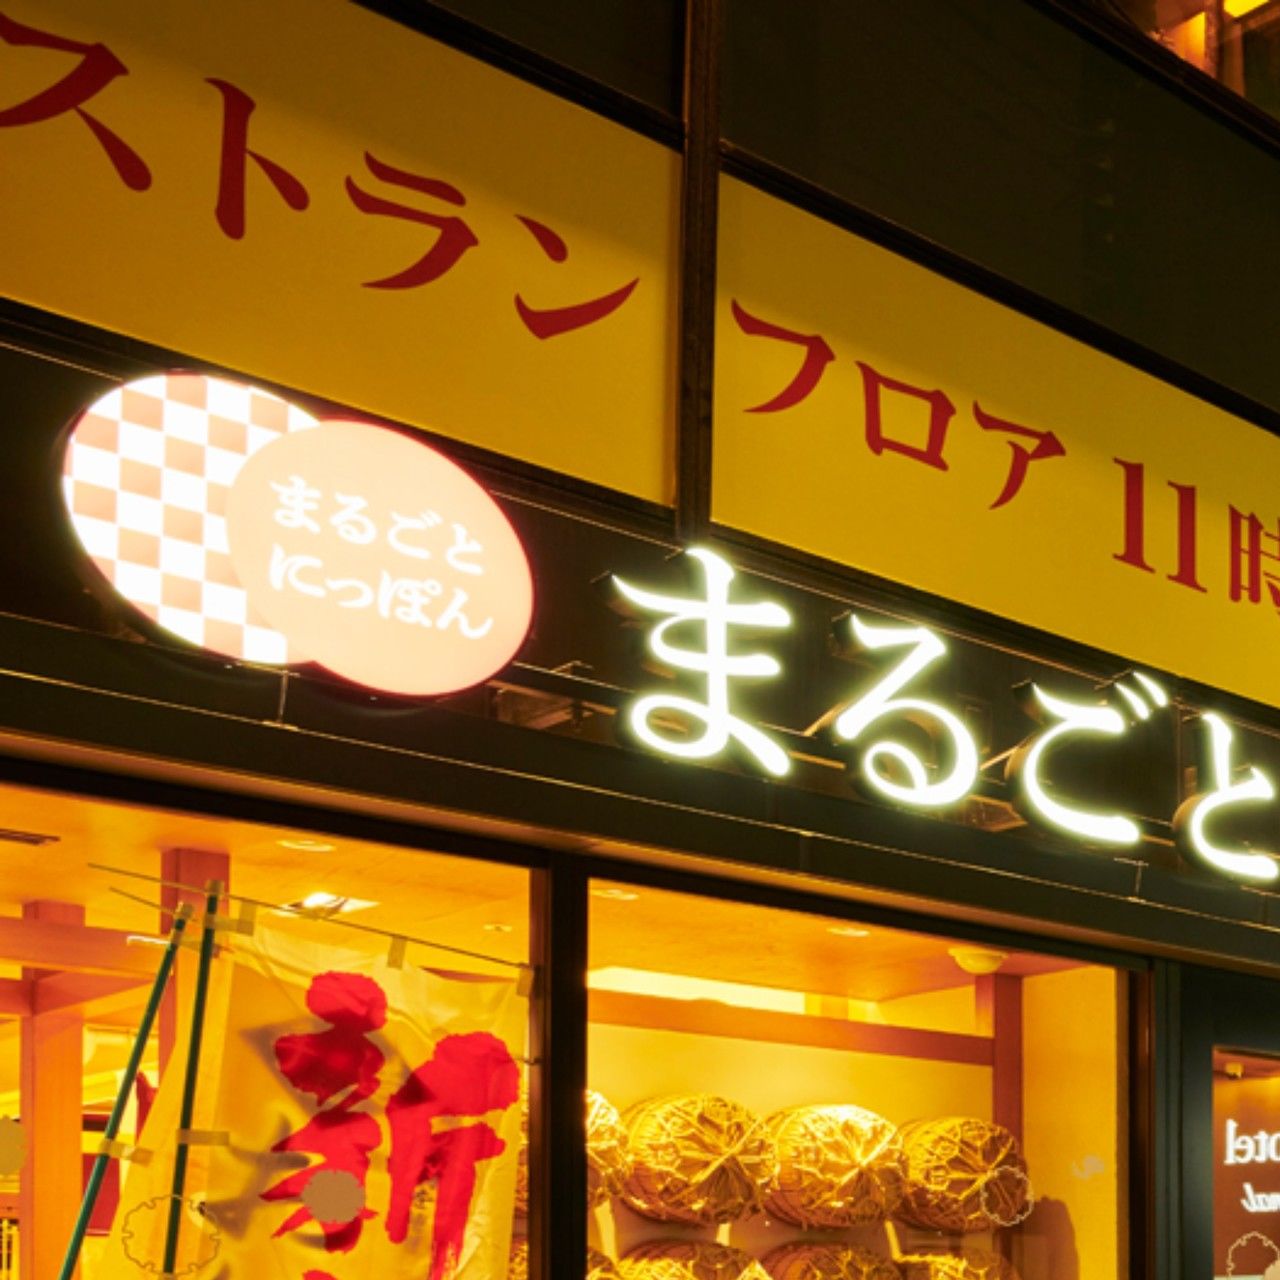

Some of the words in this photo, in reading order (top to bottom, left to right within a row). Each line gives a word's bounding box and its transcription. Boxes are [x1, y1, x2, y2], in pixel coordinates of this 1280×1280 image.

[269, 476, 485, 575] まるごと
[269, 547, 494, 641] にっぽん
